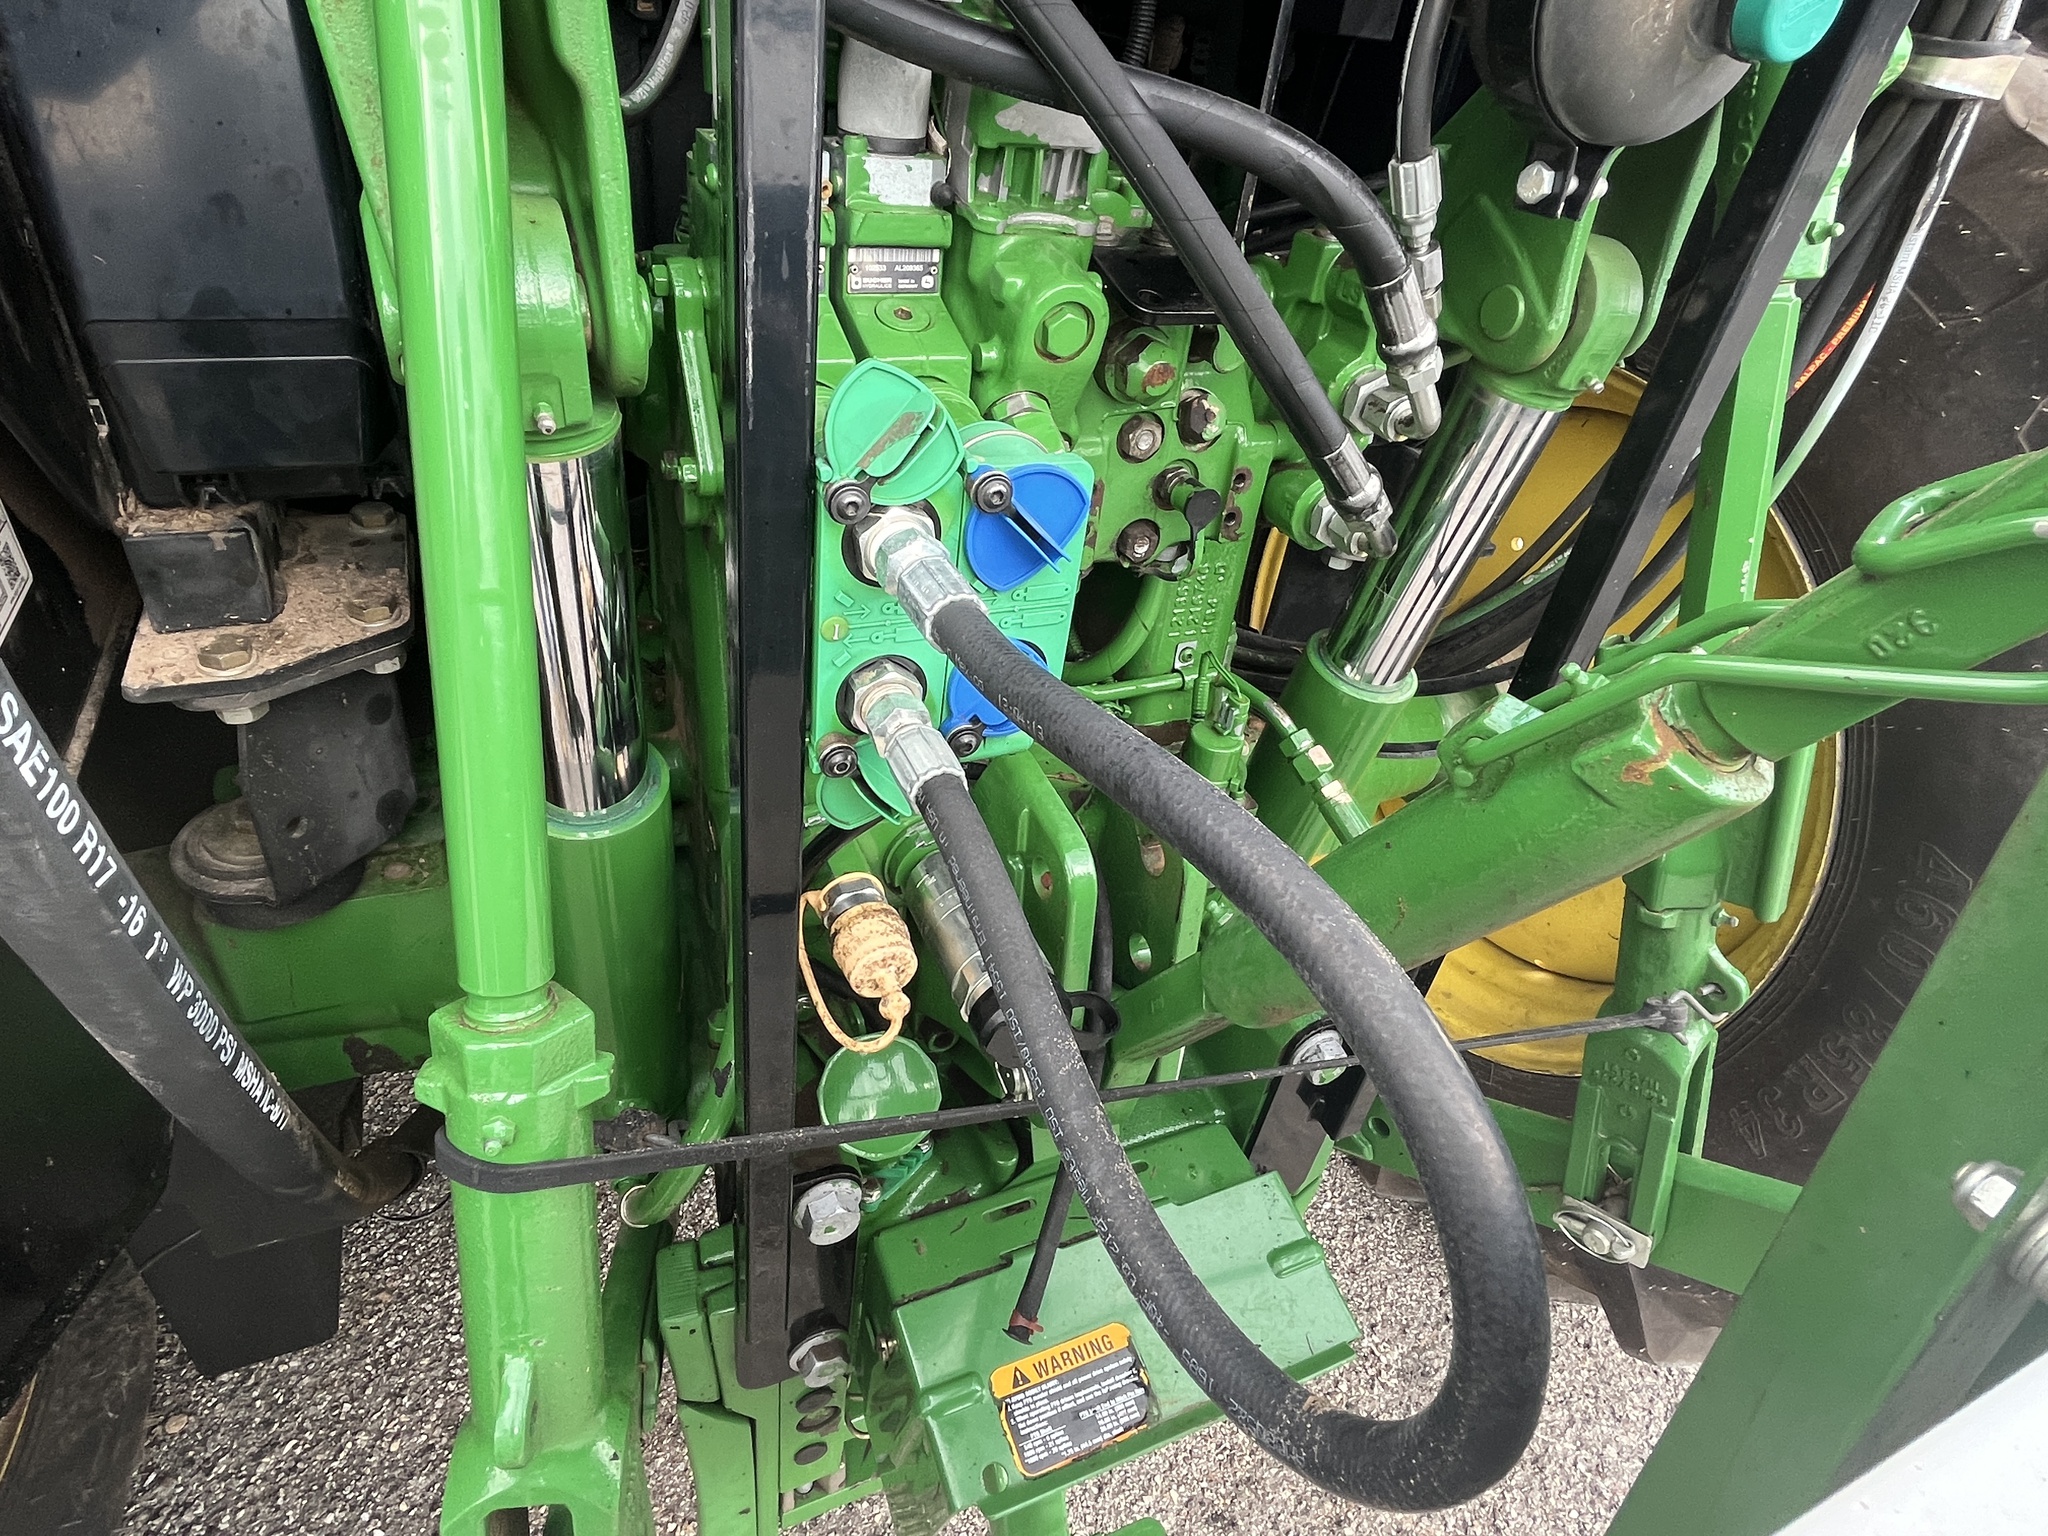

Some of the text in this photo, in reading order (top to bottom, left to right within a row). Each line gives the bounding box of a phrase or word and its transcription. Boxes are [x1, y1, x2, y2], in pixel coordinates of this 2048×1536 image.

[1831, 299, 1868, 346] PREMIUM
[926, 802, 940, 832] USA
[0, 691, 81, 835] SAE100
[72, 820, 118, 888] R17
[117, 894, 148, 937] -16
[144, 930, 170, 961] 1"
[165, 957, 195, 1003] WP
[186, 990, 219, 1043] 3000
[211, 1024, 238, 1067] PSI
[231, 1051, 265, 1105] MSHA
[948, 855, 987, 947] Engineered
[984, 953, 1008, 1000] 15541
[1044, 1106, 1065, 1140] ISO
[1032, 1333, 1114, 1380] WARNING
